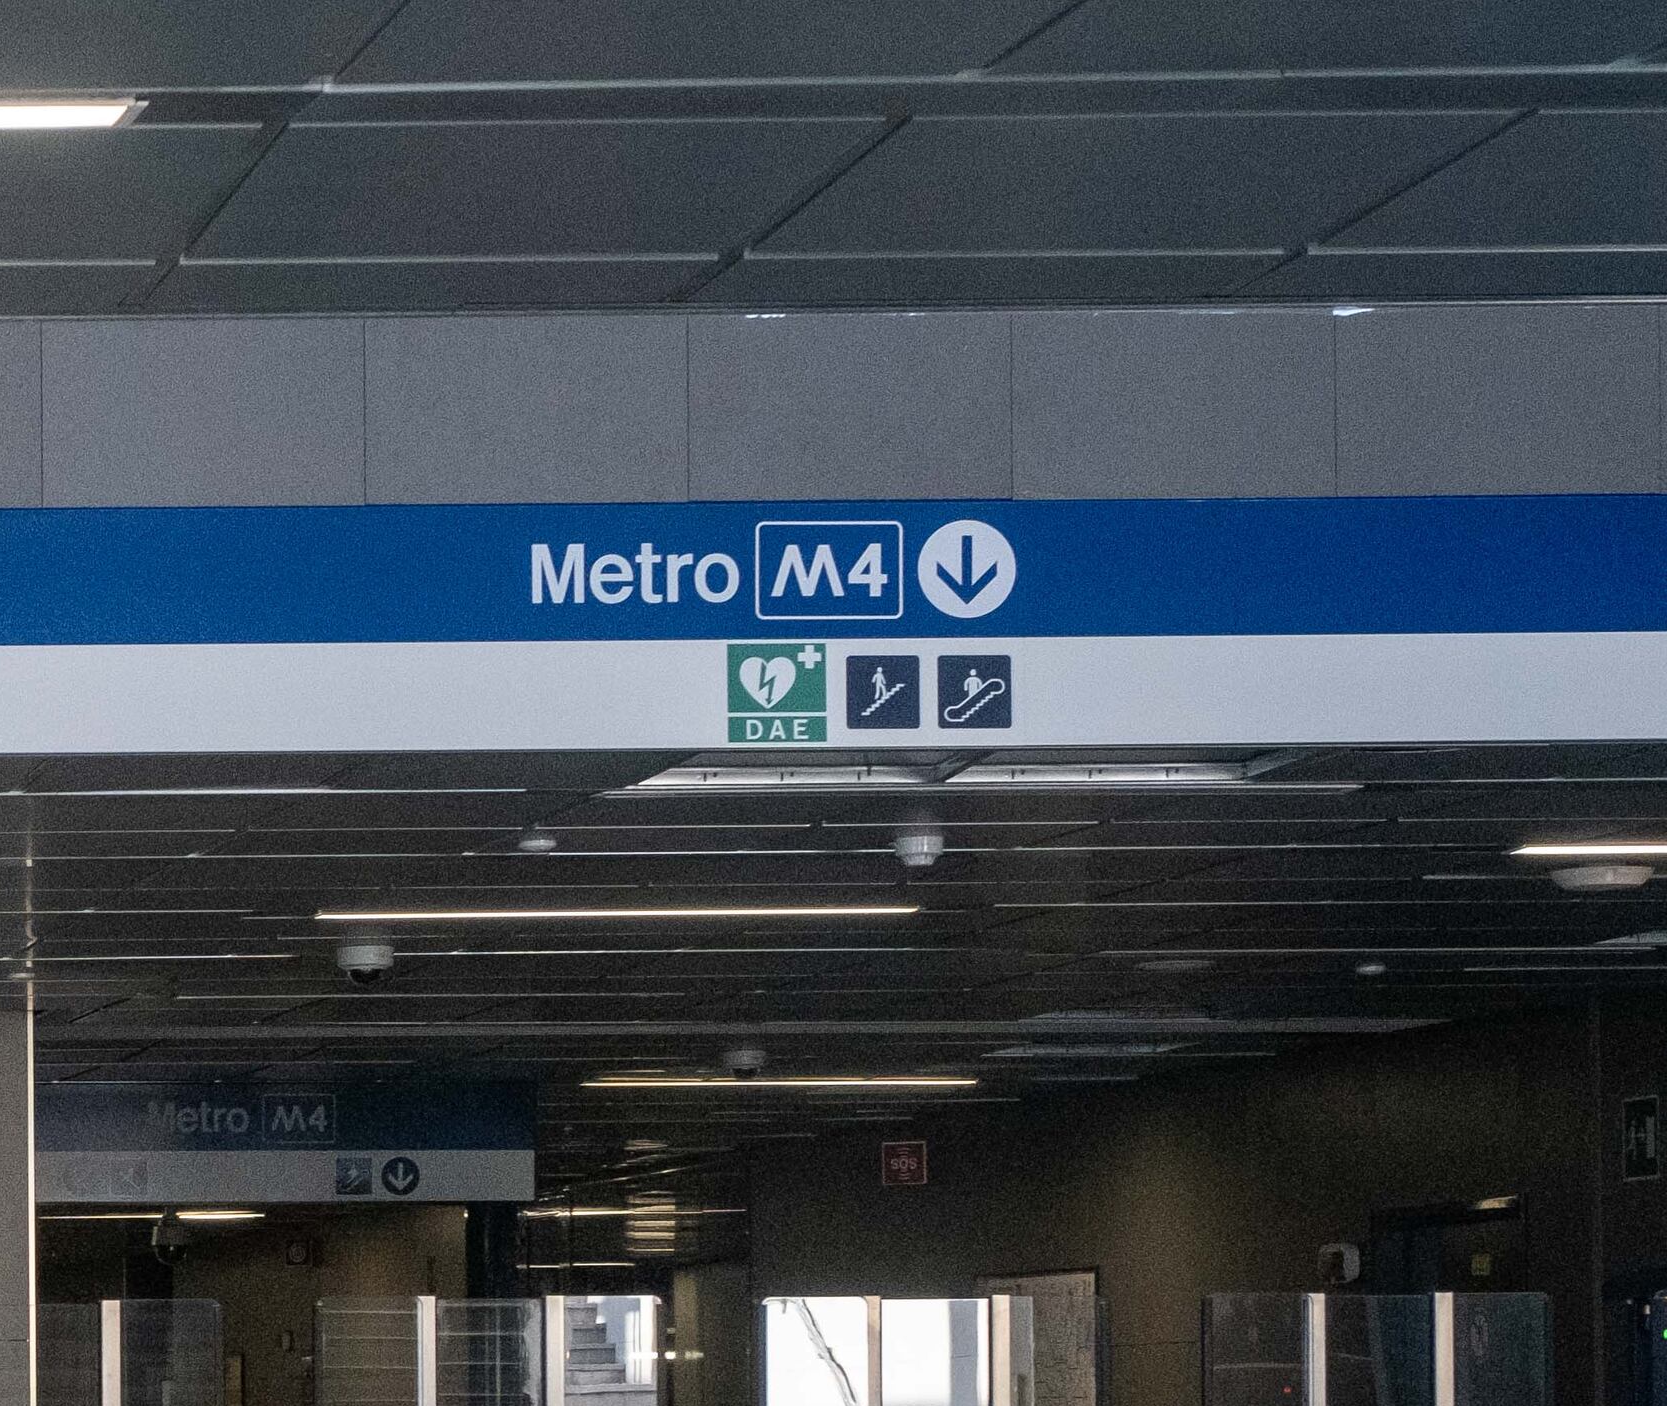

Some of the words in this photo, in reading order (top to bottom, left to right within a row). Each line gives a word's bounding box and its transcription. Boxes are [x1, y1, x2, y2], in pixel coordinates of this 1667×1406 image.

[531, 542, 740, 605] Metro
[770, 542, 888, 598] M4
[745, 718, 810, 740] DAE
[271, 1105, 328, 1132] M4
[890, 1158, 918, 1170] SOS
